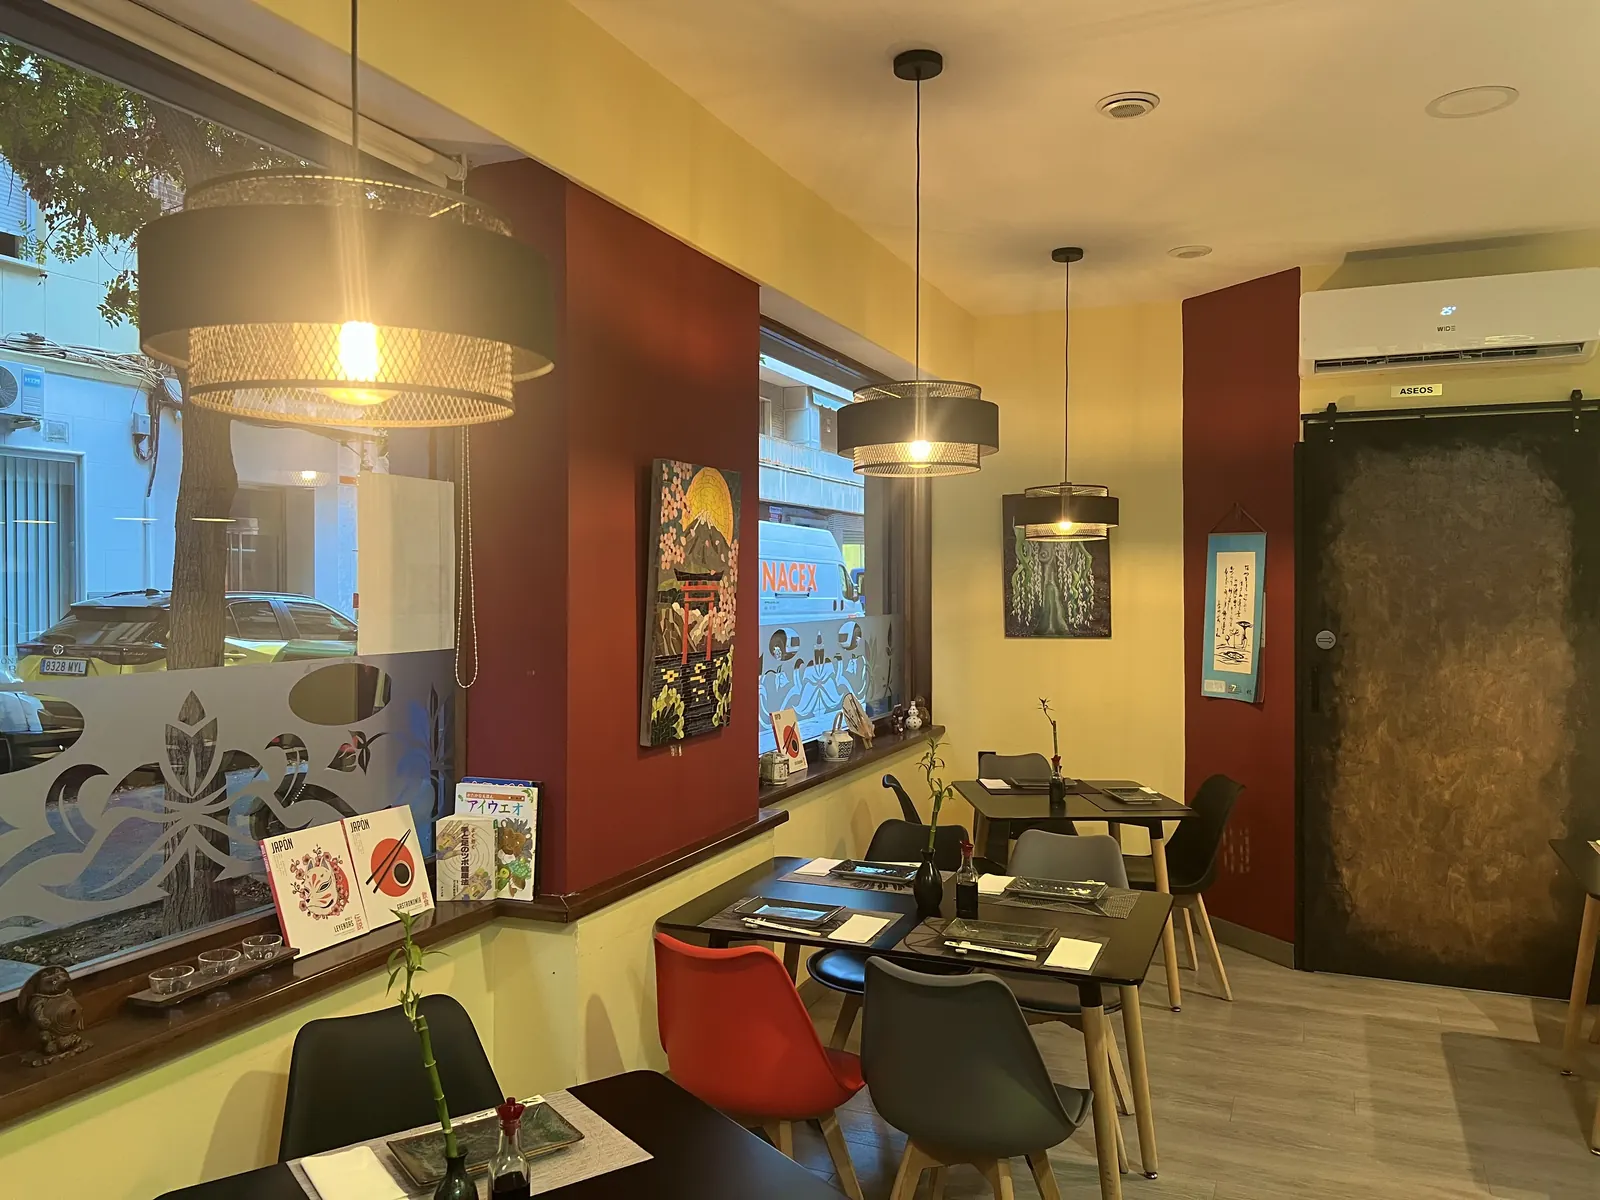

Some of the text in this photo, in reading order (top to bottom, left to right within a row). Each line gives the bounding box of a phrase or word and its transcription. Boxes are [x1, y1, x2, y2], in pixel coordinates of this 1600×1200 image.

[1399, 386, 1433, 395] ASEOS
[762, 561, 817, 592] NACEX
[45, 661, 84, 673] 8328 MYL
[466, 799, 524, 816] アイウエオ
[349, 817, 371, 834] JAPÓN
[270, 836, 295, 854] JAPÓN
